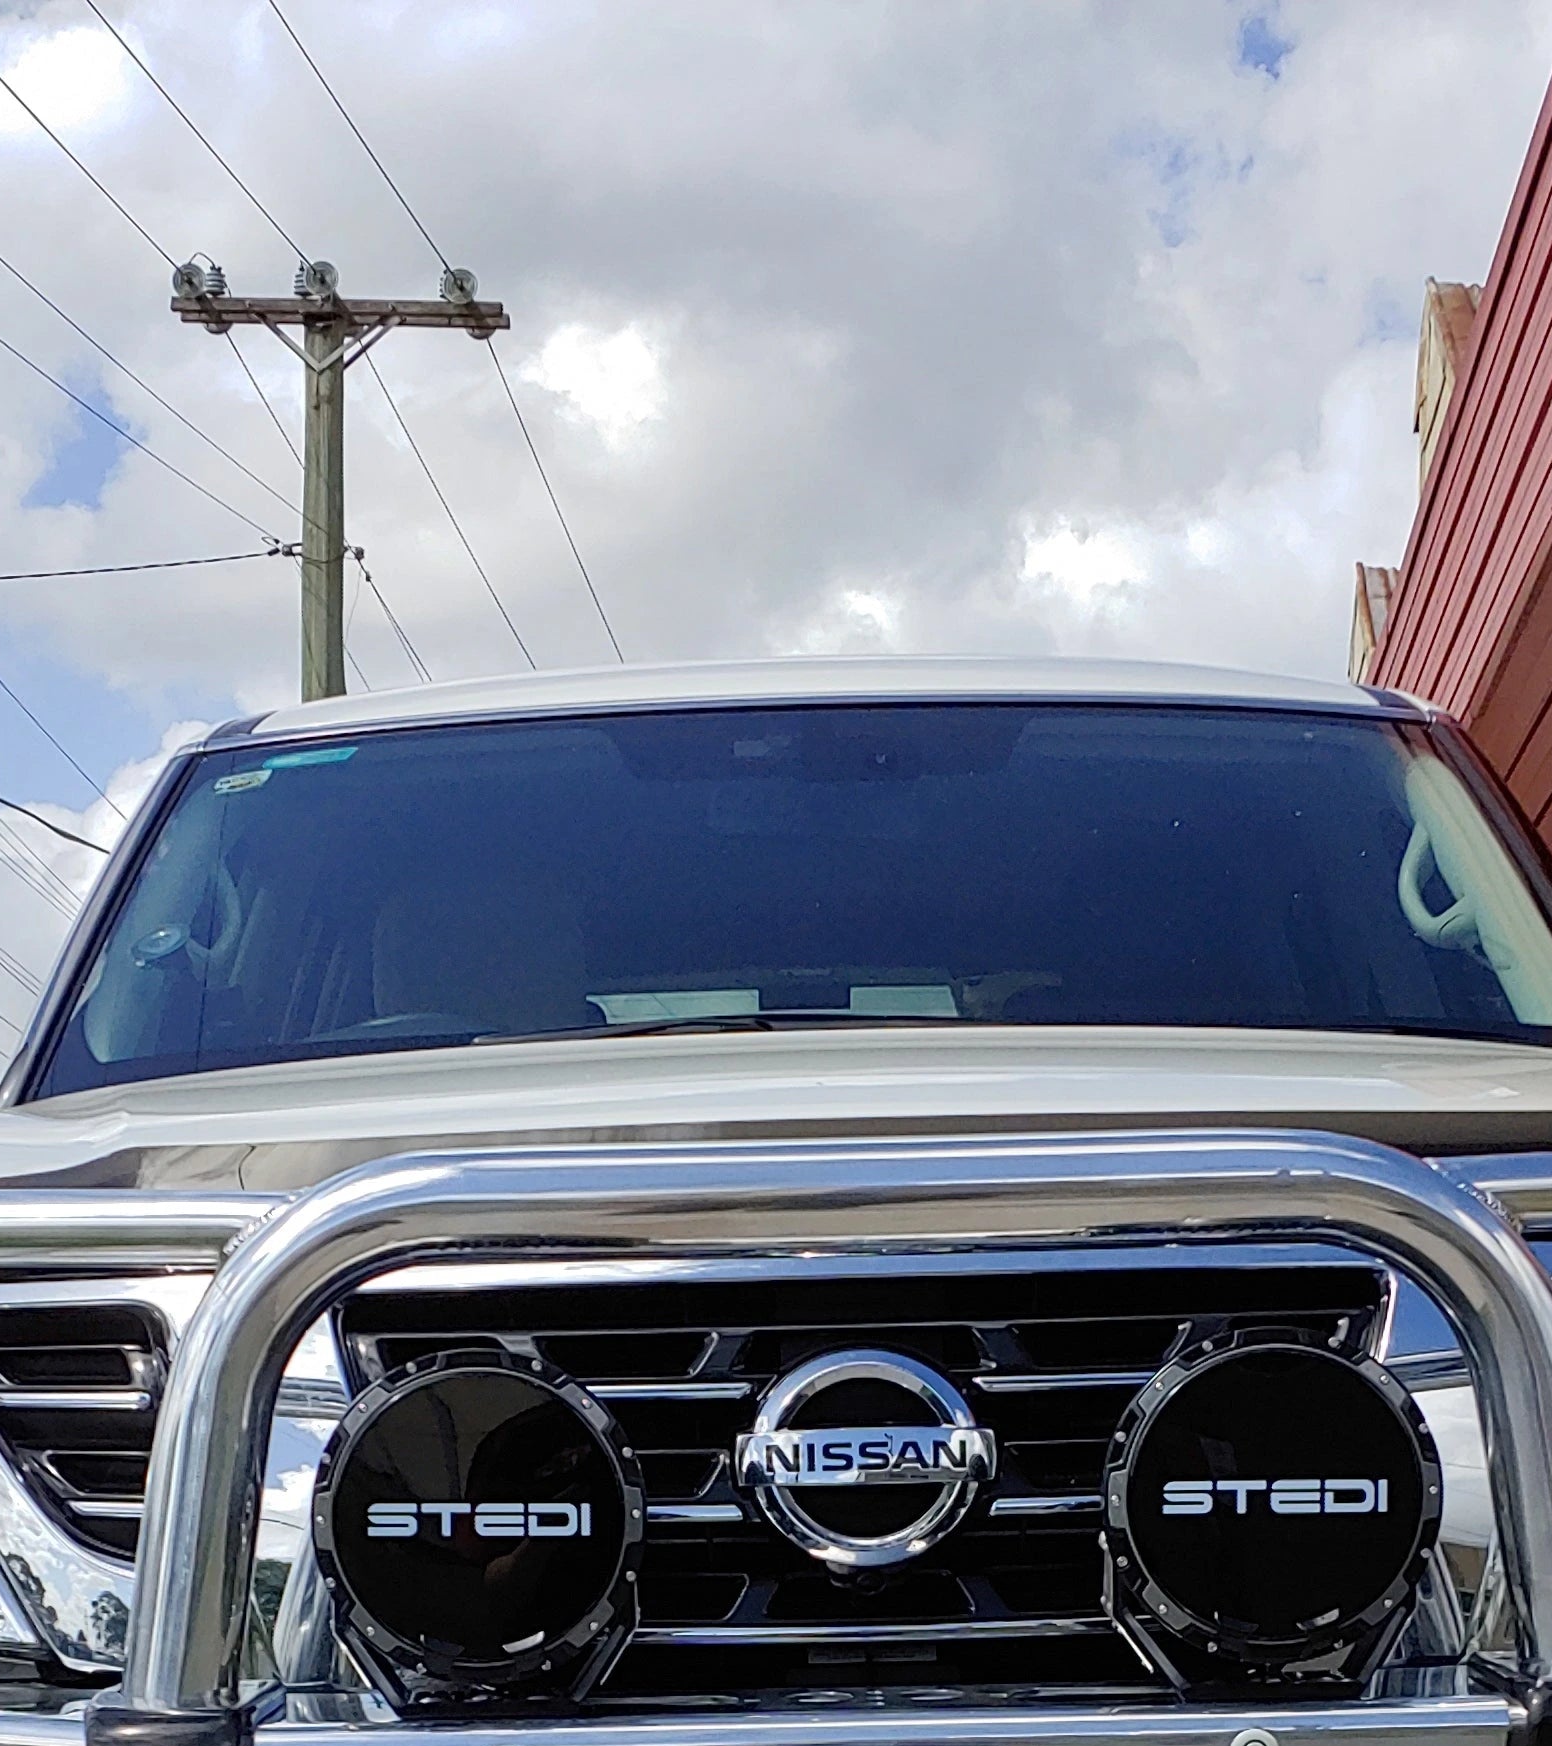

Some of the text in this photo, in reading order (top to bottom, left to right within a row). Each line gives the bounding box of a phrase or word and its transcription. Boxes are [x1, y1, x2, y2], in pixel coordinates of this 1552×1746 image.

[764, 1438, 968, 1474] NISSAN
[1161, 1478, 1389, 1515] STEDI
[366, 1502, 592, 1537] STEDI
